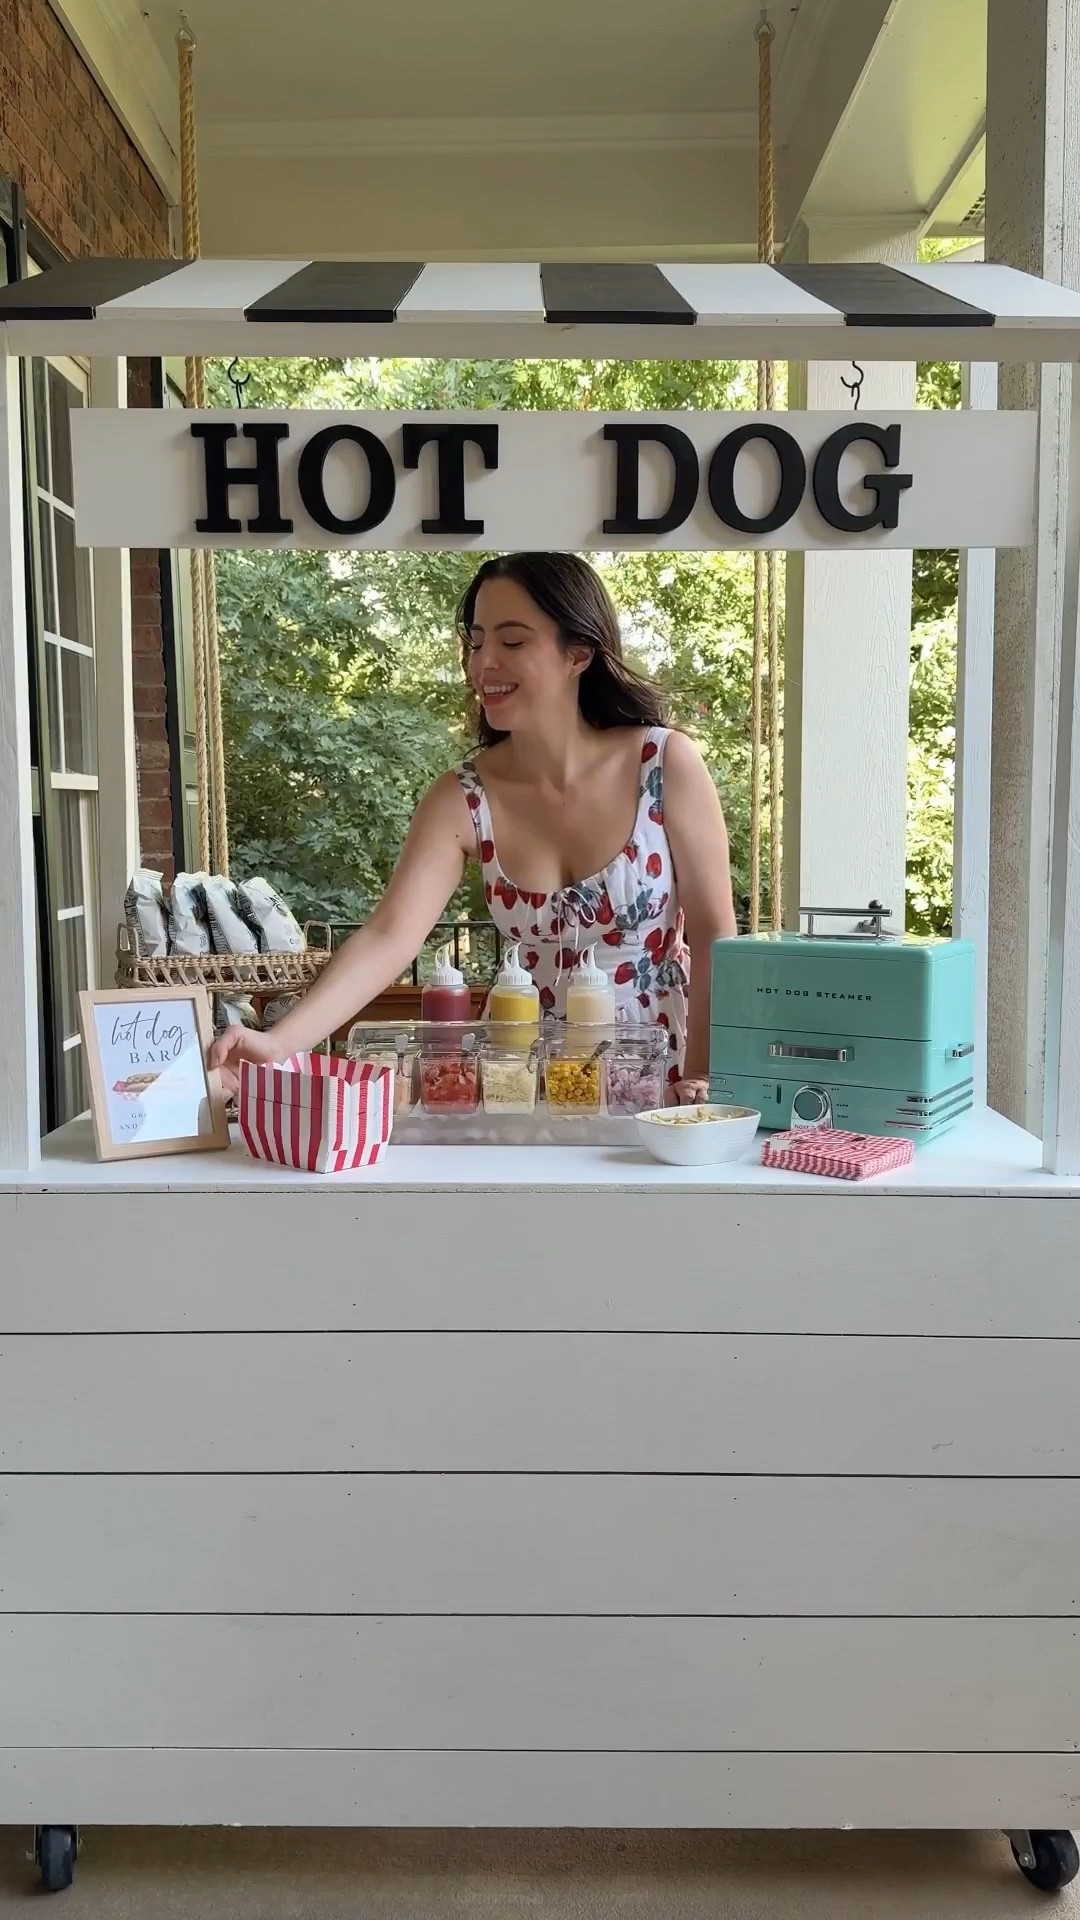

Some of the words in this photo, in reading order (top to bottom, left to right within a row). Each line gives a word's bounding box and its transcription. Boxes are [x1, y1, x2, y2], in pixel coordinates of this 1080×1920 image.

[190, 422, 500, 535] HOT
[602, 421, 914, 535] DOG
[756, 987, 780, 995] HOT
[785, 989, 809, 997] DOG
[816, 991, 872, 1001] STEAMER
[111, 1010, 154, 1050] hot
[145, 1010, 188, 1056] dog
[129, 1050, 171, 1064] BAR
